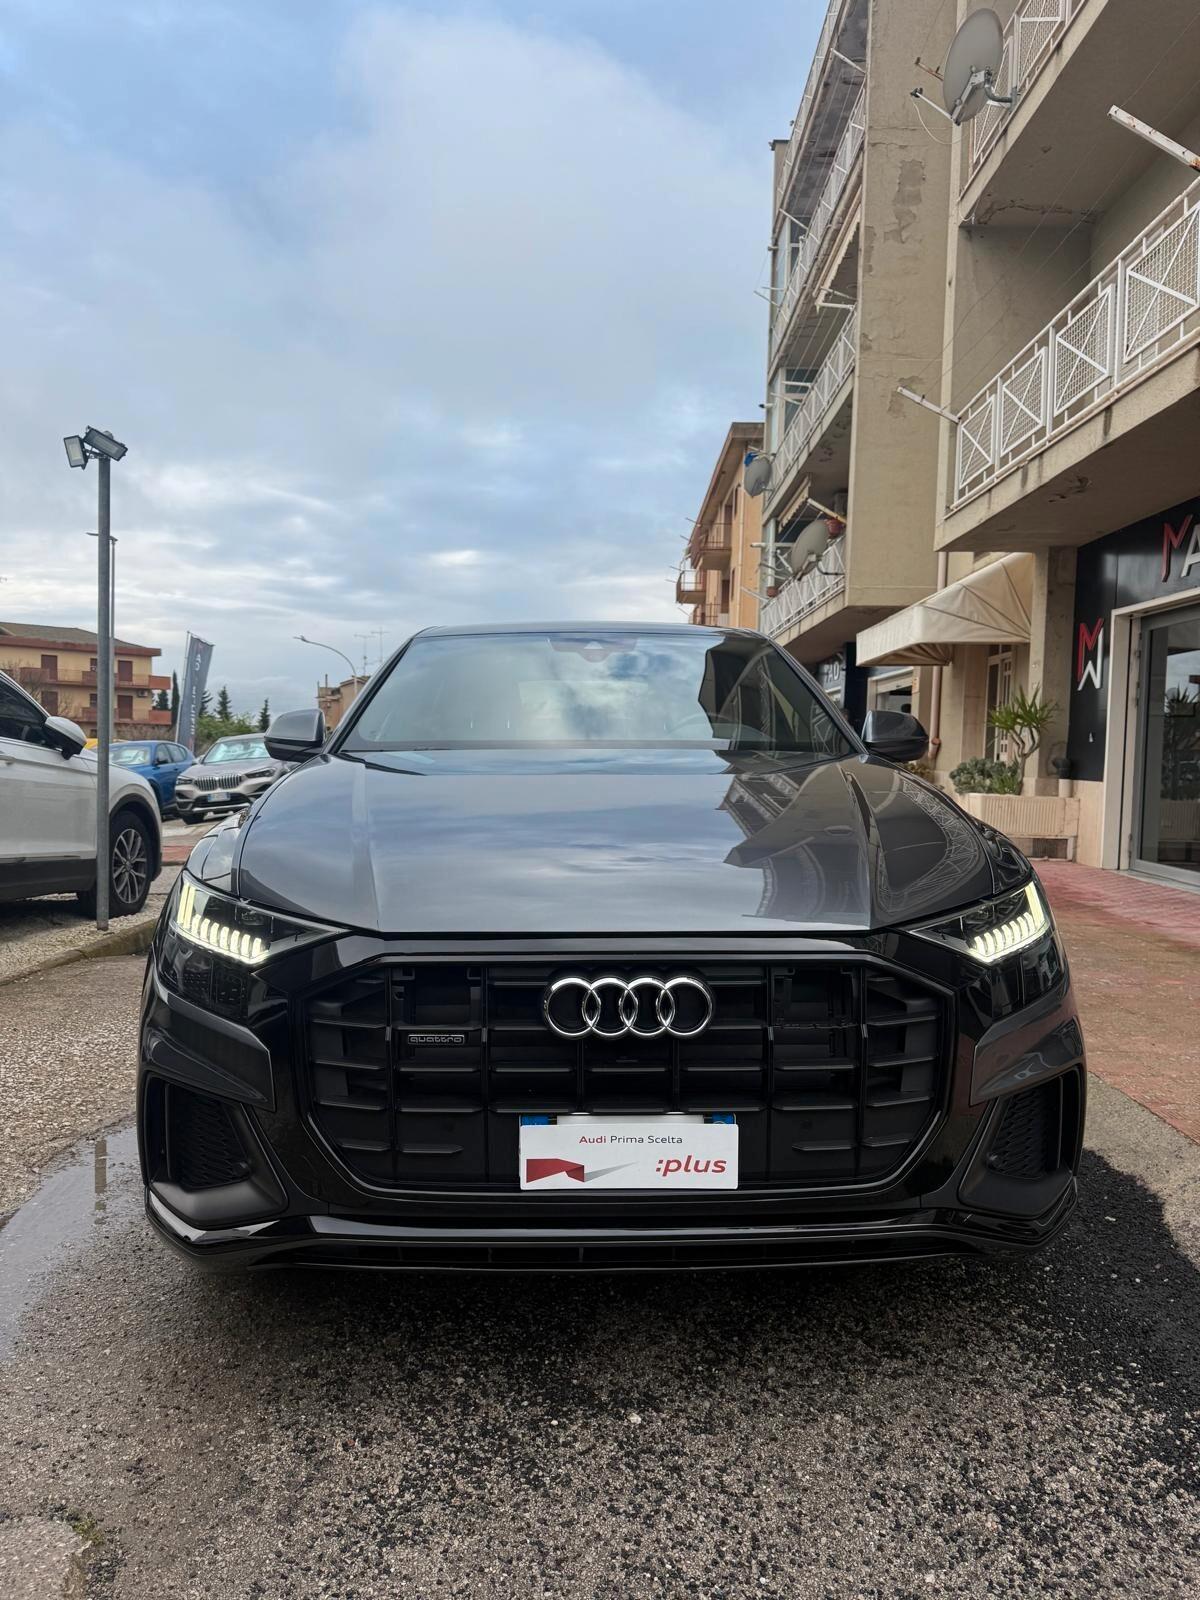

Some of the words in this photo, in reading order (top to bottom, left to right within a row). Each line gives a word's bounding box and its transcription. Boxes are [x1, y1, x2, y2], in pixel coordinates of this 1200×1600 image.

[409, 1035, 463, 1044] quattro
[579, 1135, 607, 1144] Audi
[610, 1135, 644, 1144] Prima
[647, 1135, 683, 1144] Scelta
